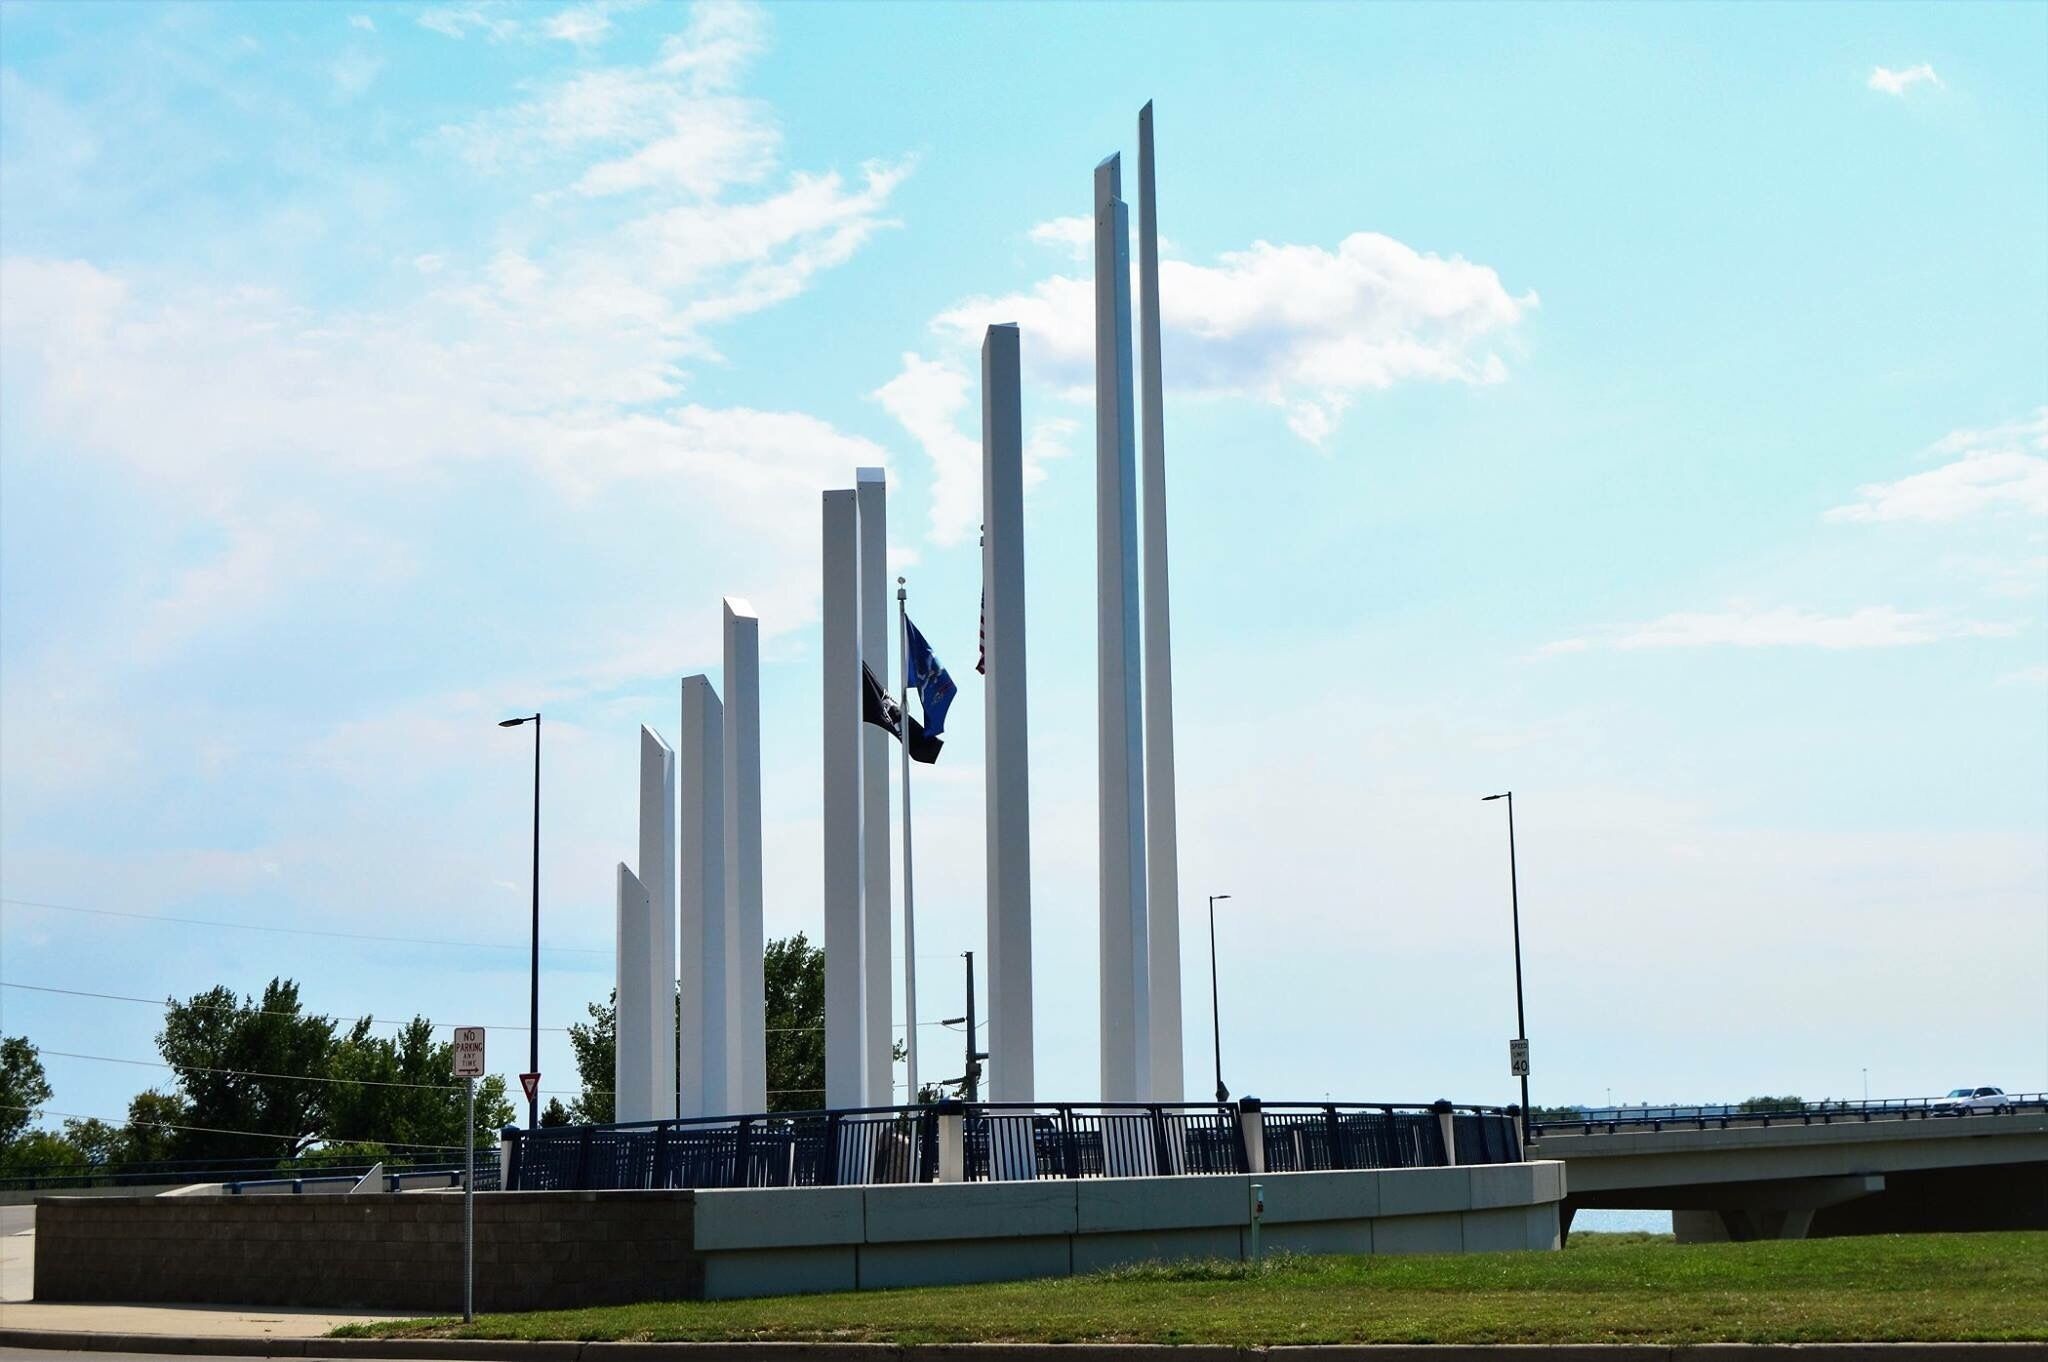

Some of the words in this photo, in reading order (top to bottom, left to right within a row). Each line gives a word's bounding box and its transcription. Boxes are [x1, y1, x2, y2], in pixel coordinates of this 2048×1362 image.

[464, 1032, 475, 1041] NO
[456, 1043, 482, 1052] PARKING
[1513, 1060, 1527, 1071] 40
